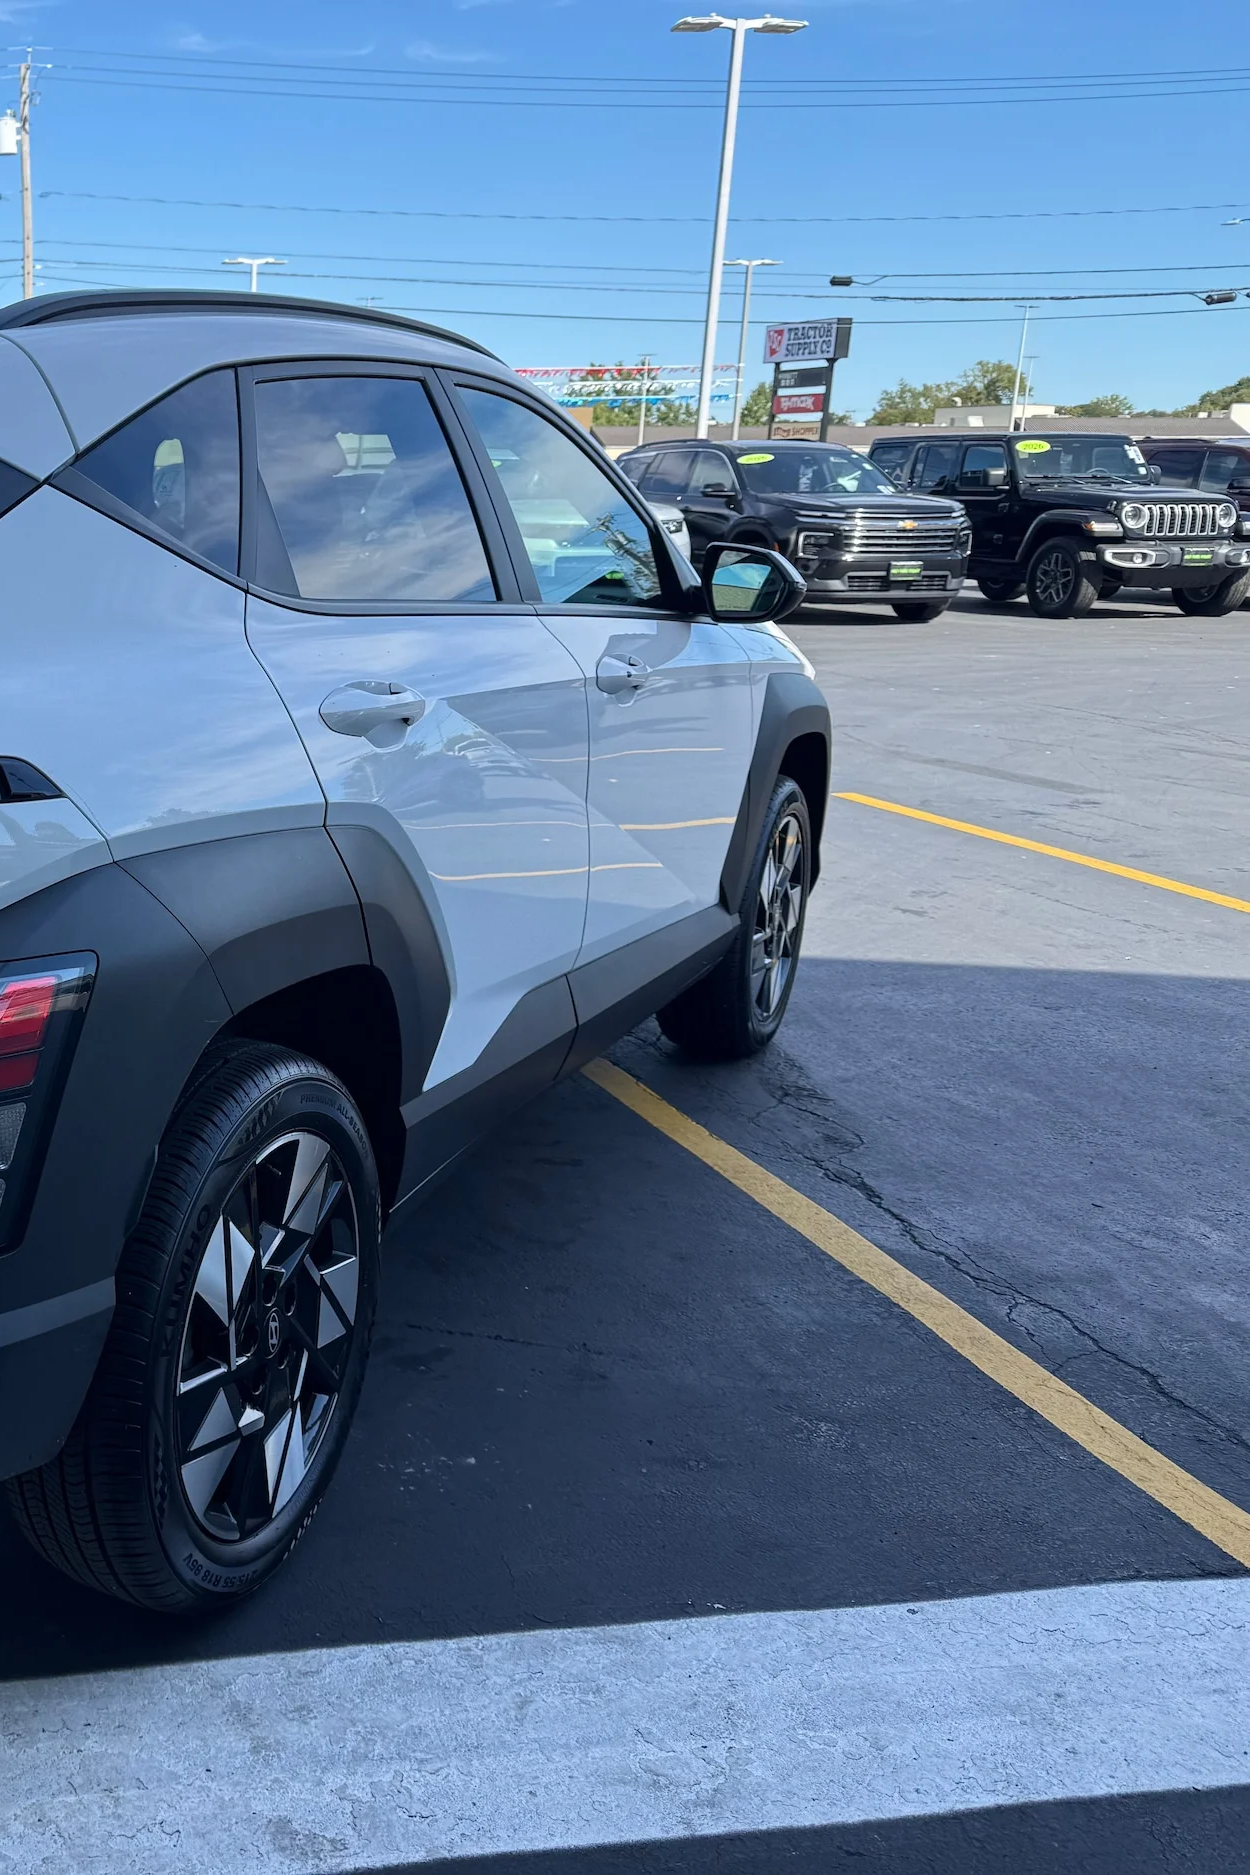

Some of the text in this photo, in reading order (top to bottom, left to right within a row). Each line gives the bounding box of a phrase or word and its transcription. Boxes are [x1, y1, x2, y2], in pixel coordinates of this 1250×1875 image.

[787, 324, 833, 342] TRACTOR
[785, 341, 819, 357] SUPPLY
[159, 1203, 212, 1358] KUMHO
